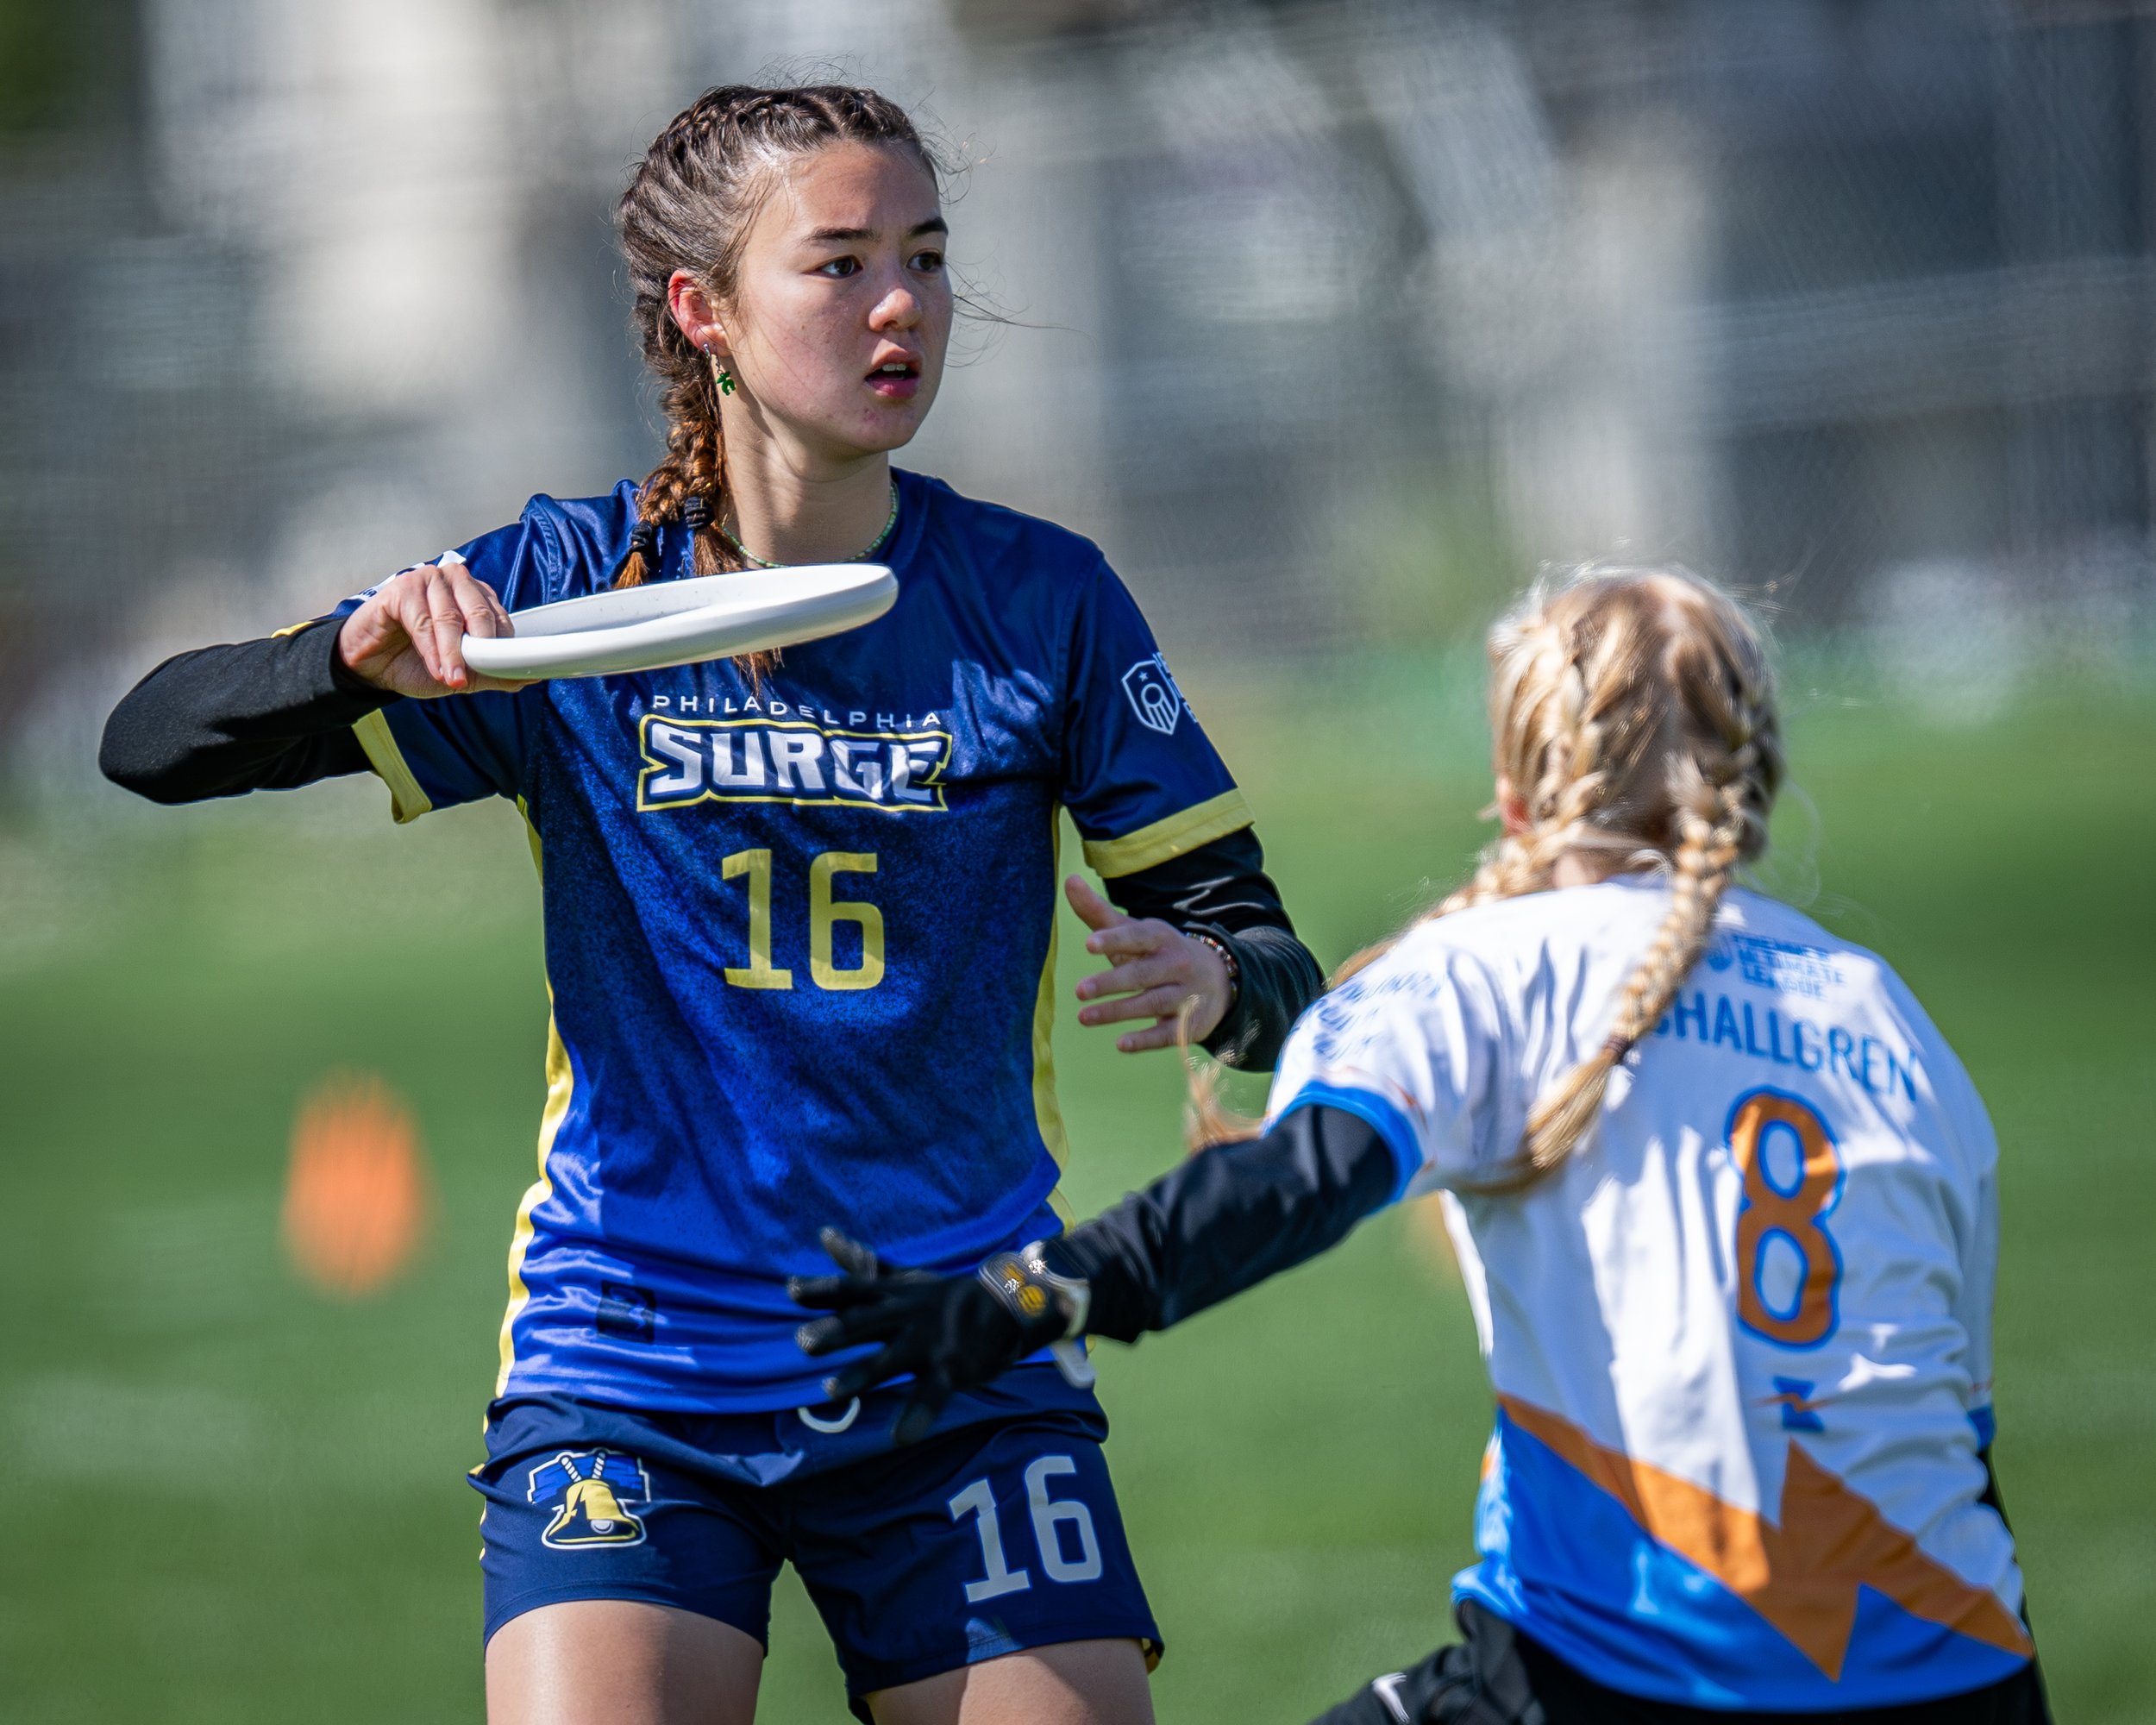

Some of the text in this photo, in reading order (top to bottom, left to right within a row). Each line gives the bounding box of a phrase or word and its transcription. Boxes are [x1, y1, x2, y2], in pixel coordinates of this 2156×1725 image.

[649, 722, 943, 802] SURGE
[652, 694, 942, 728] PHILADELPHIA
[722, 848, 885, 991] 16
[1725, 1084, 1847, 1352] 8
[948, 1454, 1102, 1603] 16
